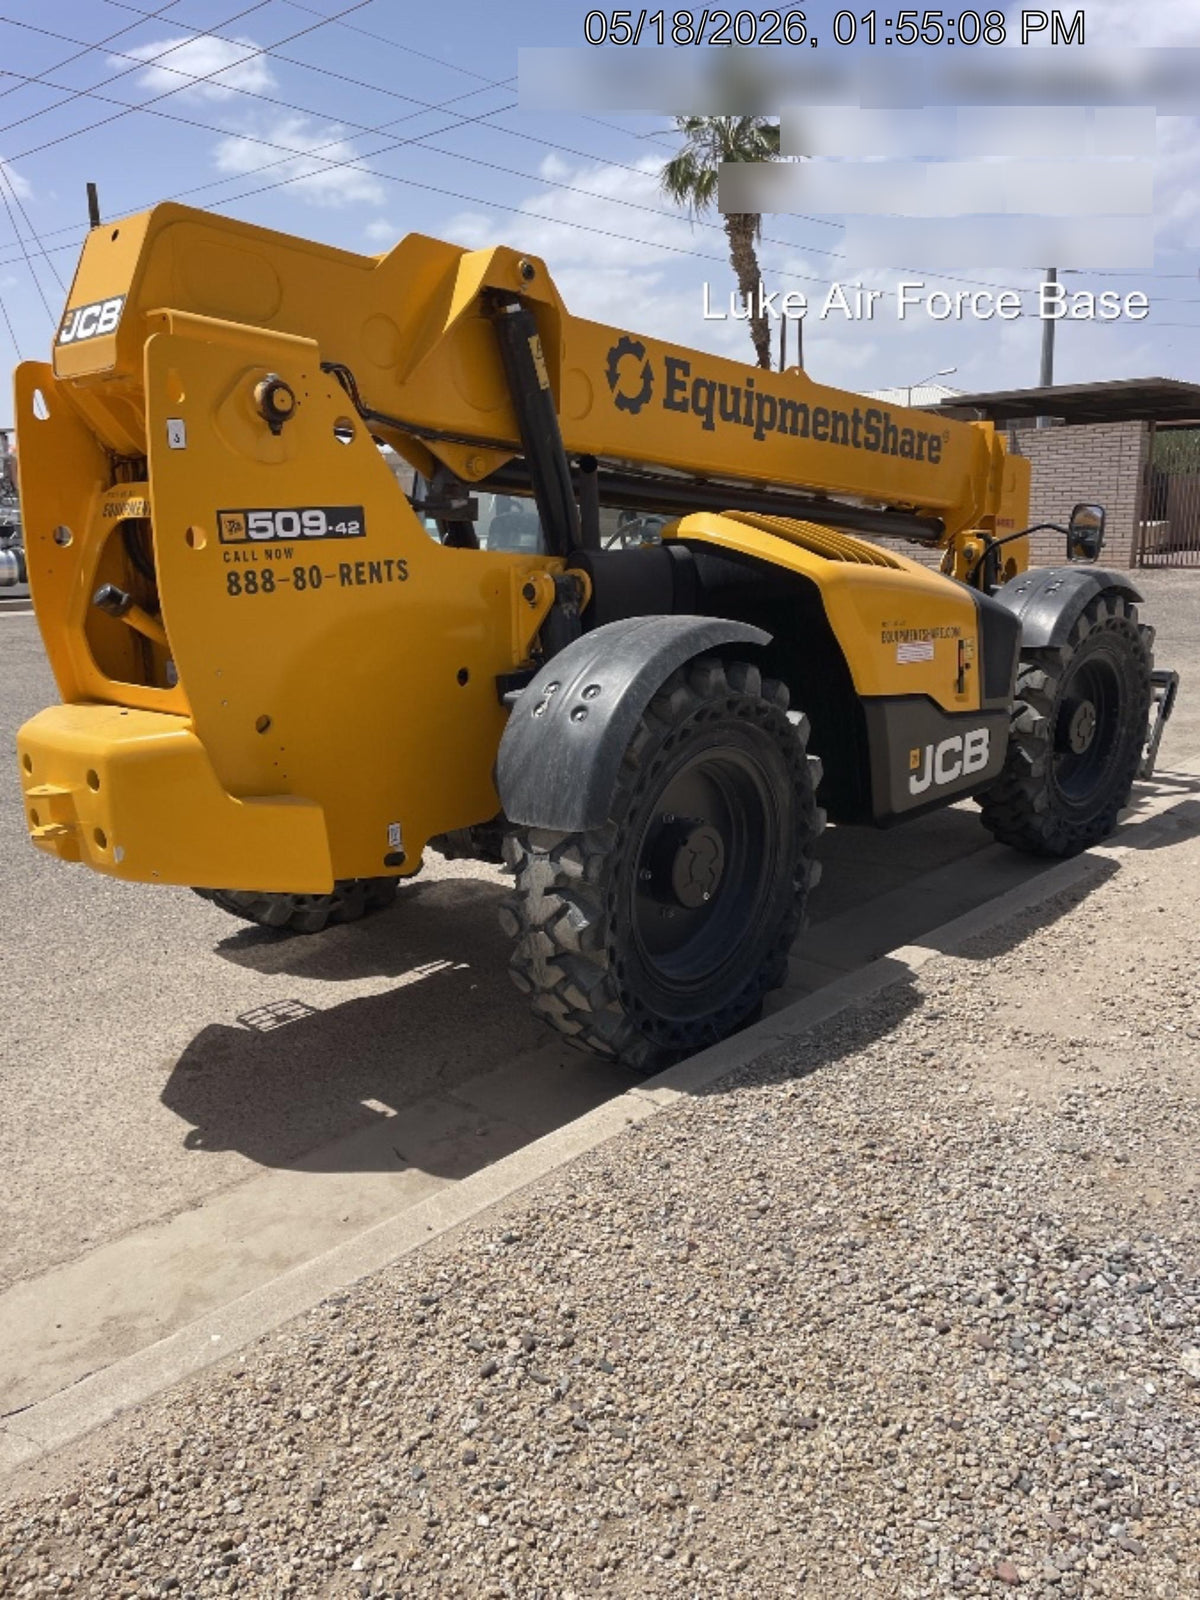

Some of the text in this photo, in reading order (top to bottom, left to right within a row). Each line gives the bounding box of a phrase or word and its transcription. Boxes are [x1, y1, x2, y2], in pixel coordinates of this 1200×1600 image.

[60, 298, 123, 343] JCB
[662, 356, 942, 464] EquipmentShare
[223, 547, 295, 564] CALL NOW
[226, 559, 409, 597] 888-80-RENTS
[909, 727, 990, 796] JCB
